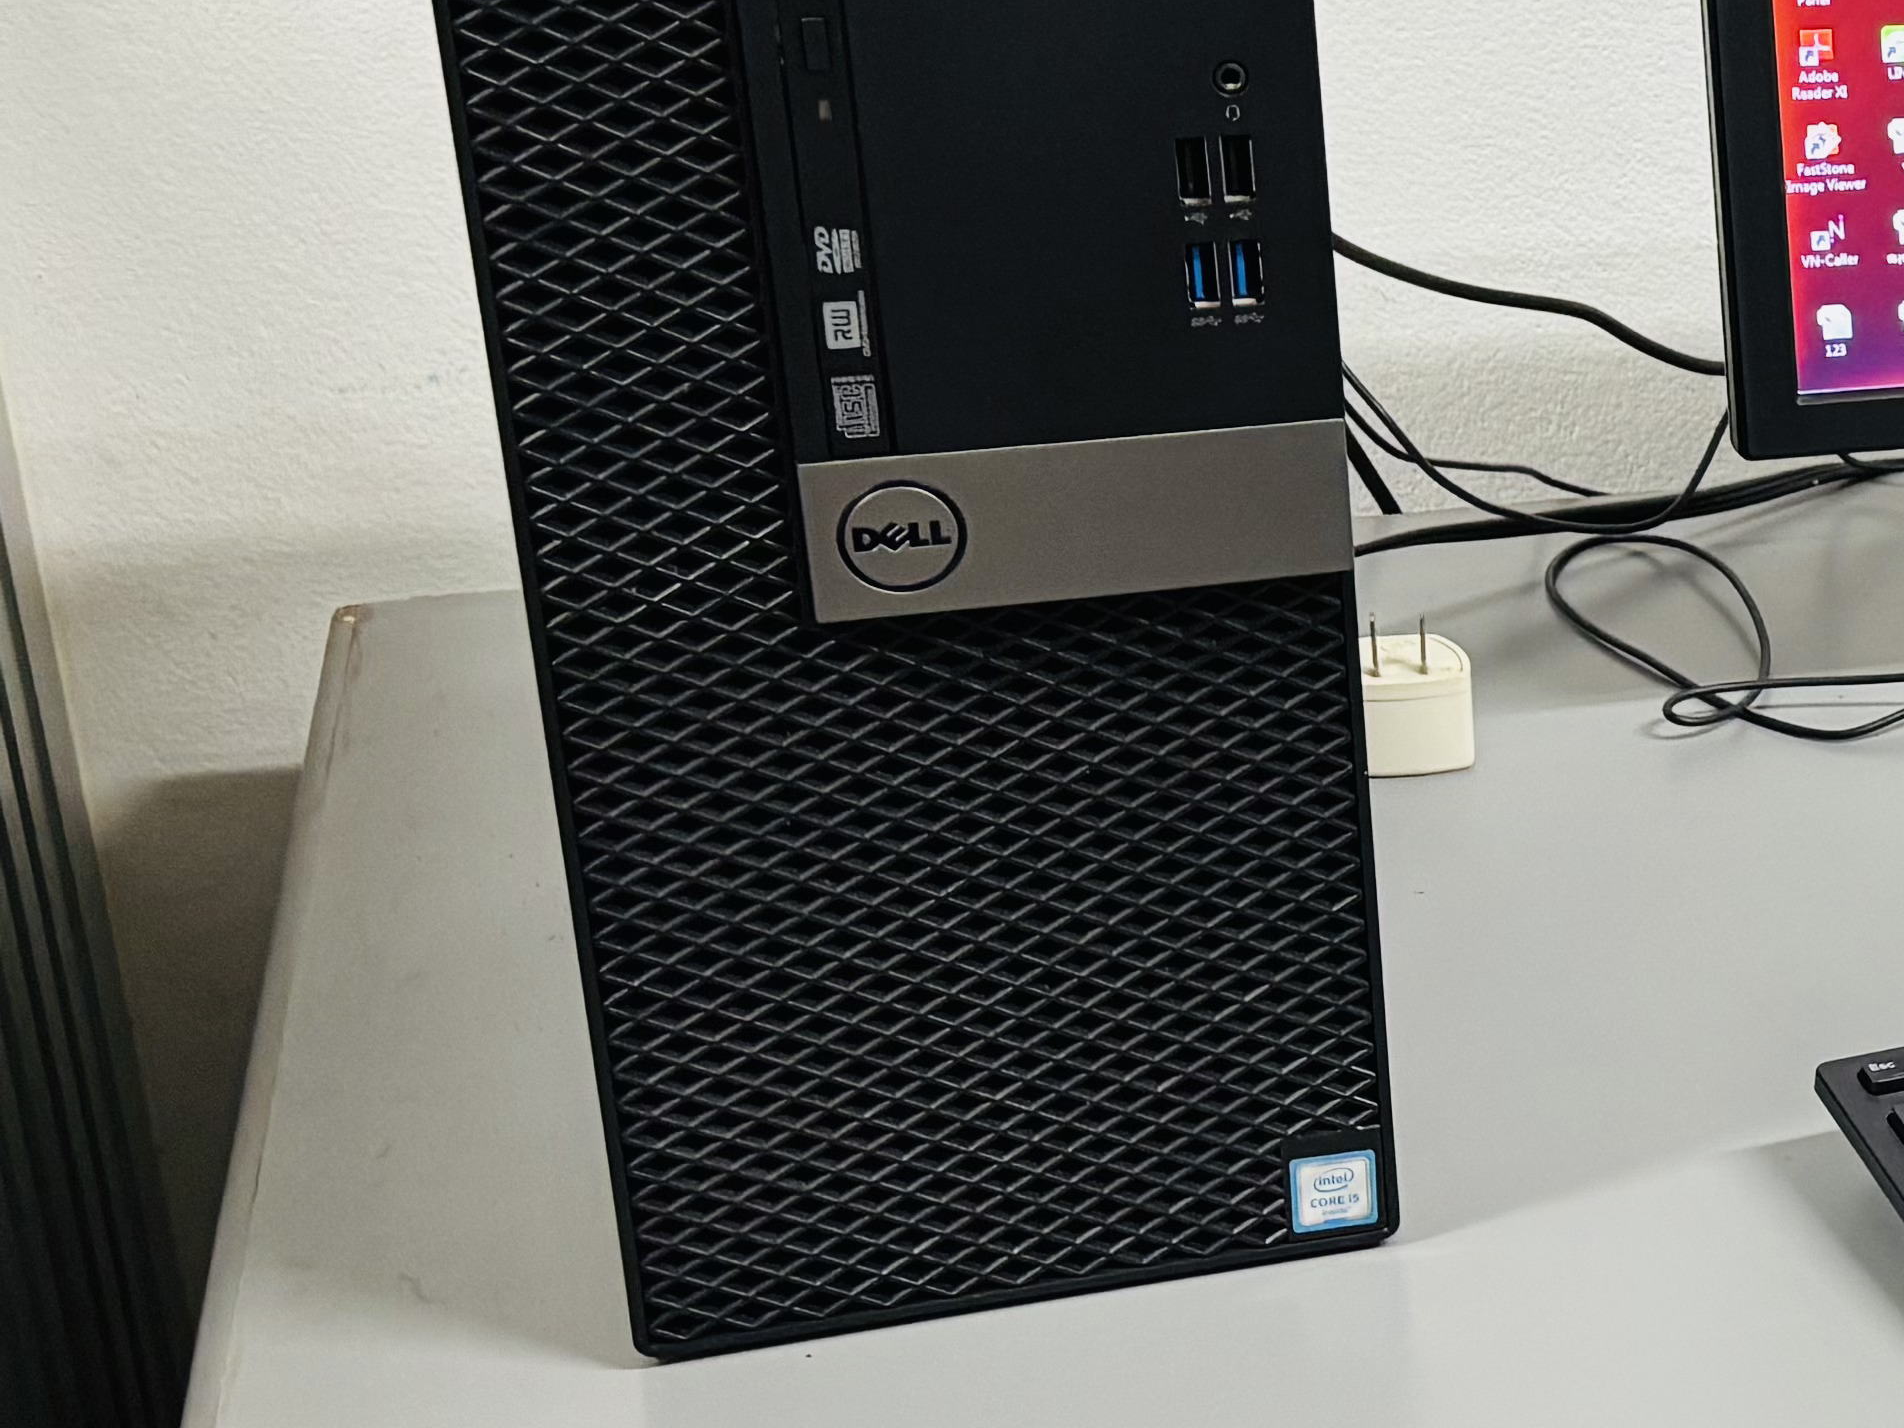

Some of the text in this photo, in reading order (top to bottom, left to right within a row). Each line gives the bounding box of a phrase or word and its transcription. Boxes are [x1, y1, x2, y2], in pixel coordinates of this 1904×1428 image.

[1798, 70, 1839, 84] Adobe
[1792, 87, 1835, 100] Reader
[1826, 178, 1867, 192] Viewer
[1825, 343, 1847, 357] 123
[851, 519, 952, 553] DELL
[1318, 1172, 1349, 1187] intel
[1310, 1195, 1345, 1208] CORE
